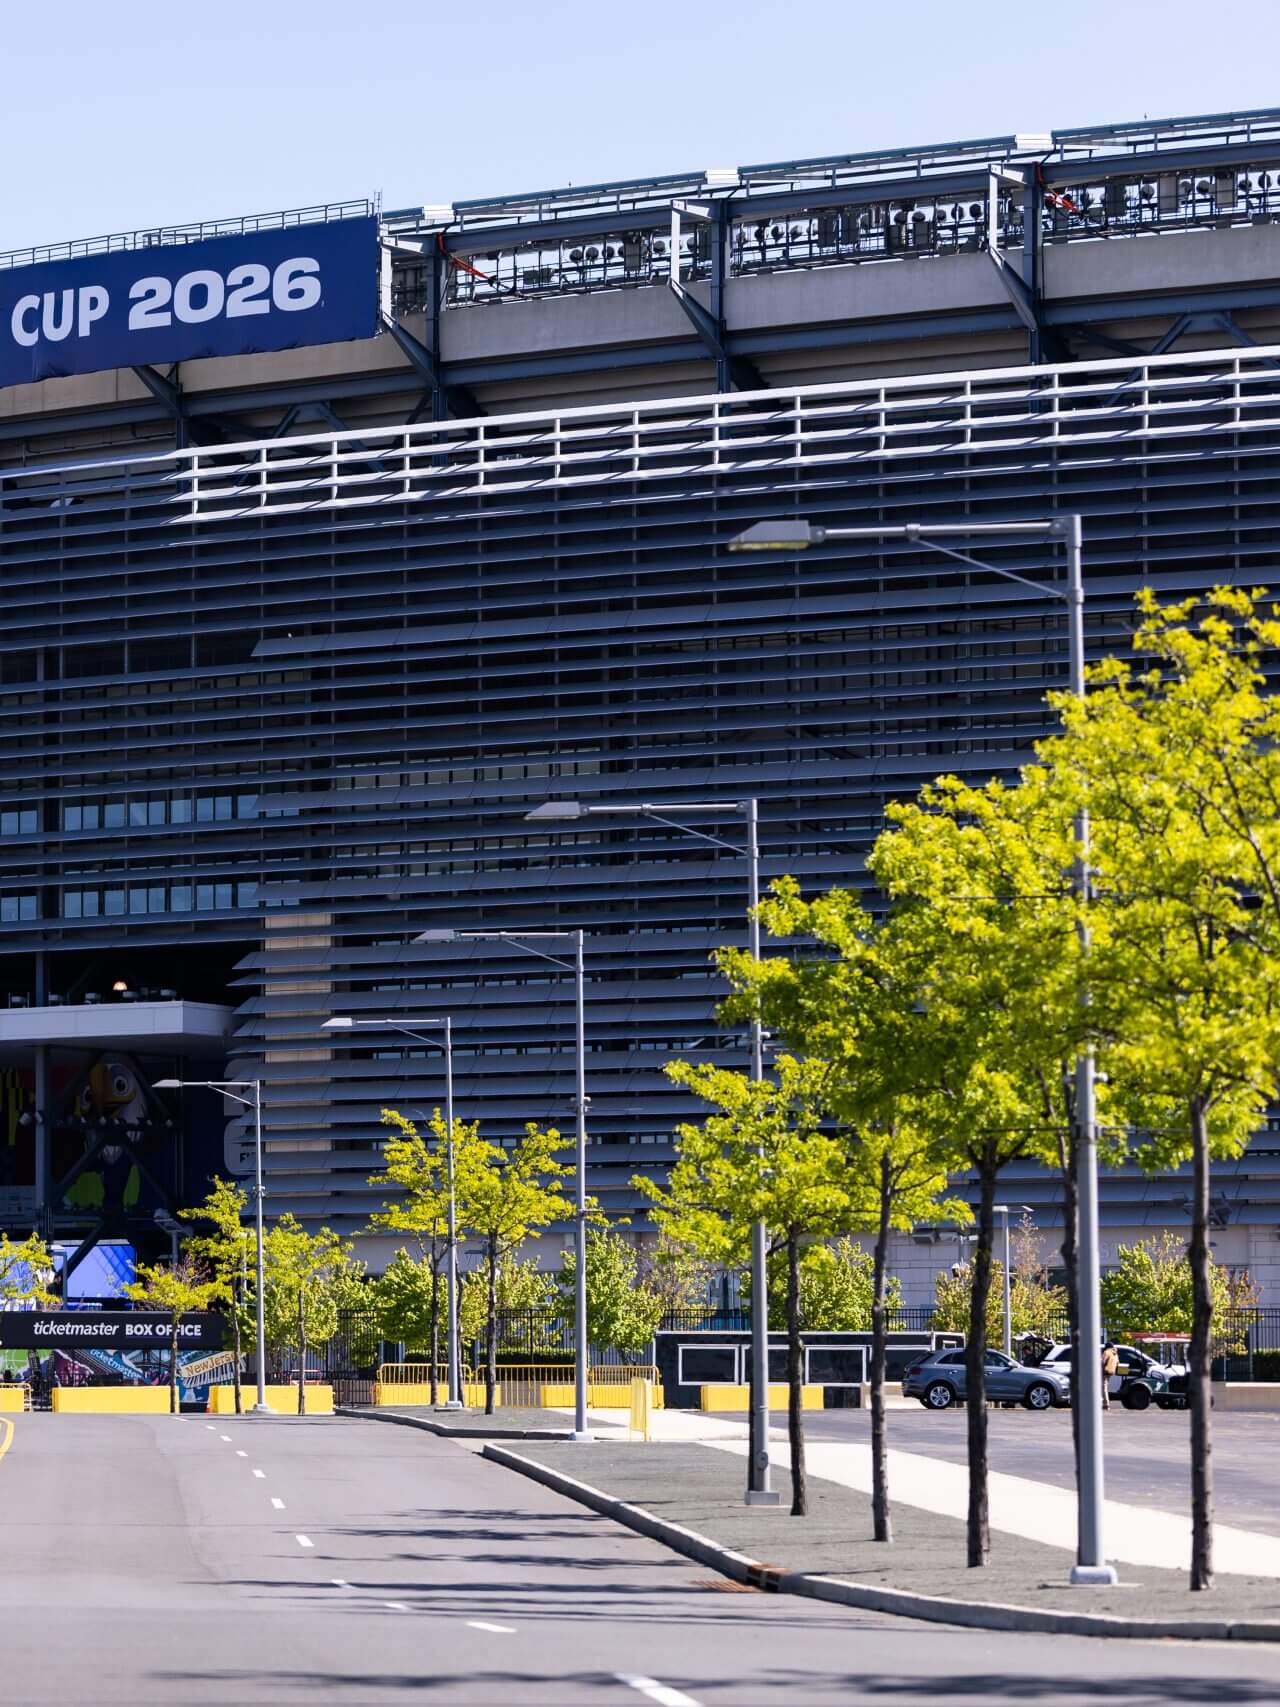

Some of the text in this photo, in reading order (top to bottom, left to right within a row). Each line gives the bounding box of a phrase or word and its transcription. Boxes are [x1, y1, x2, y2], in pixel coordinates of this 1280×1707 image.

[11, 285, 110, 347] CUP
[128, 256, 322, 331] 2026
[33, 1320, 120, 1336] ticketmaster
[125, 1323, 153, 1336] BOX
